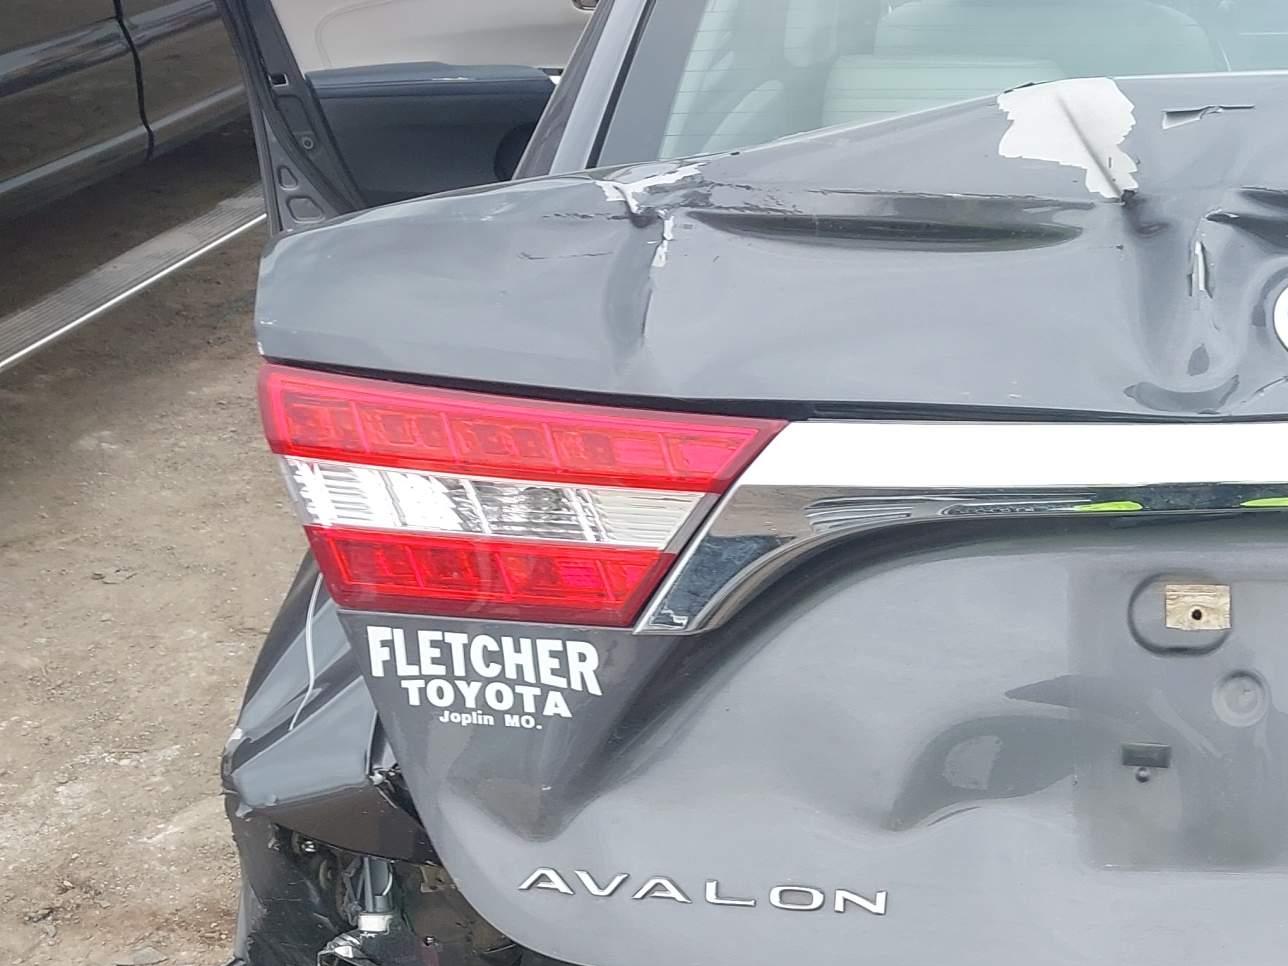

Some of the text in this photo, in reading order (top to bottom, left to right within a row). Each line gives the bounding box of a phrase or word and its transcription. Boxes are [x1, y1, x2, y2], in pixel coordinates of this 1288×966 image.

[366, 625, 603, 696] FLETCHER
[400, 678, 573, 718] TOYOTA
[439, 710, 543, 730] Joplin MO.
[517, 866, 888, 916] AVALON
